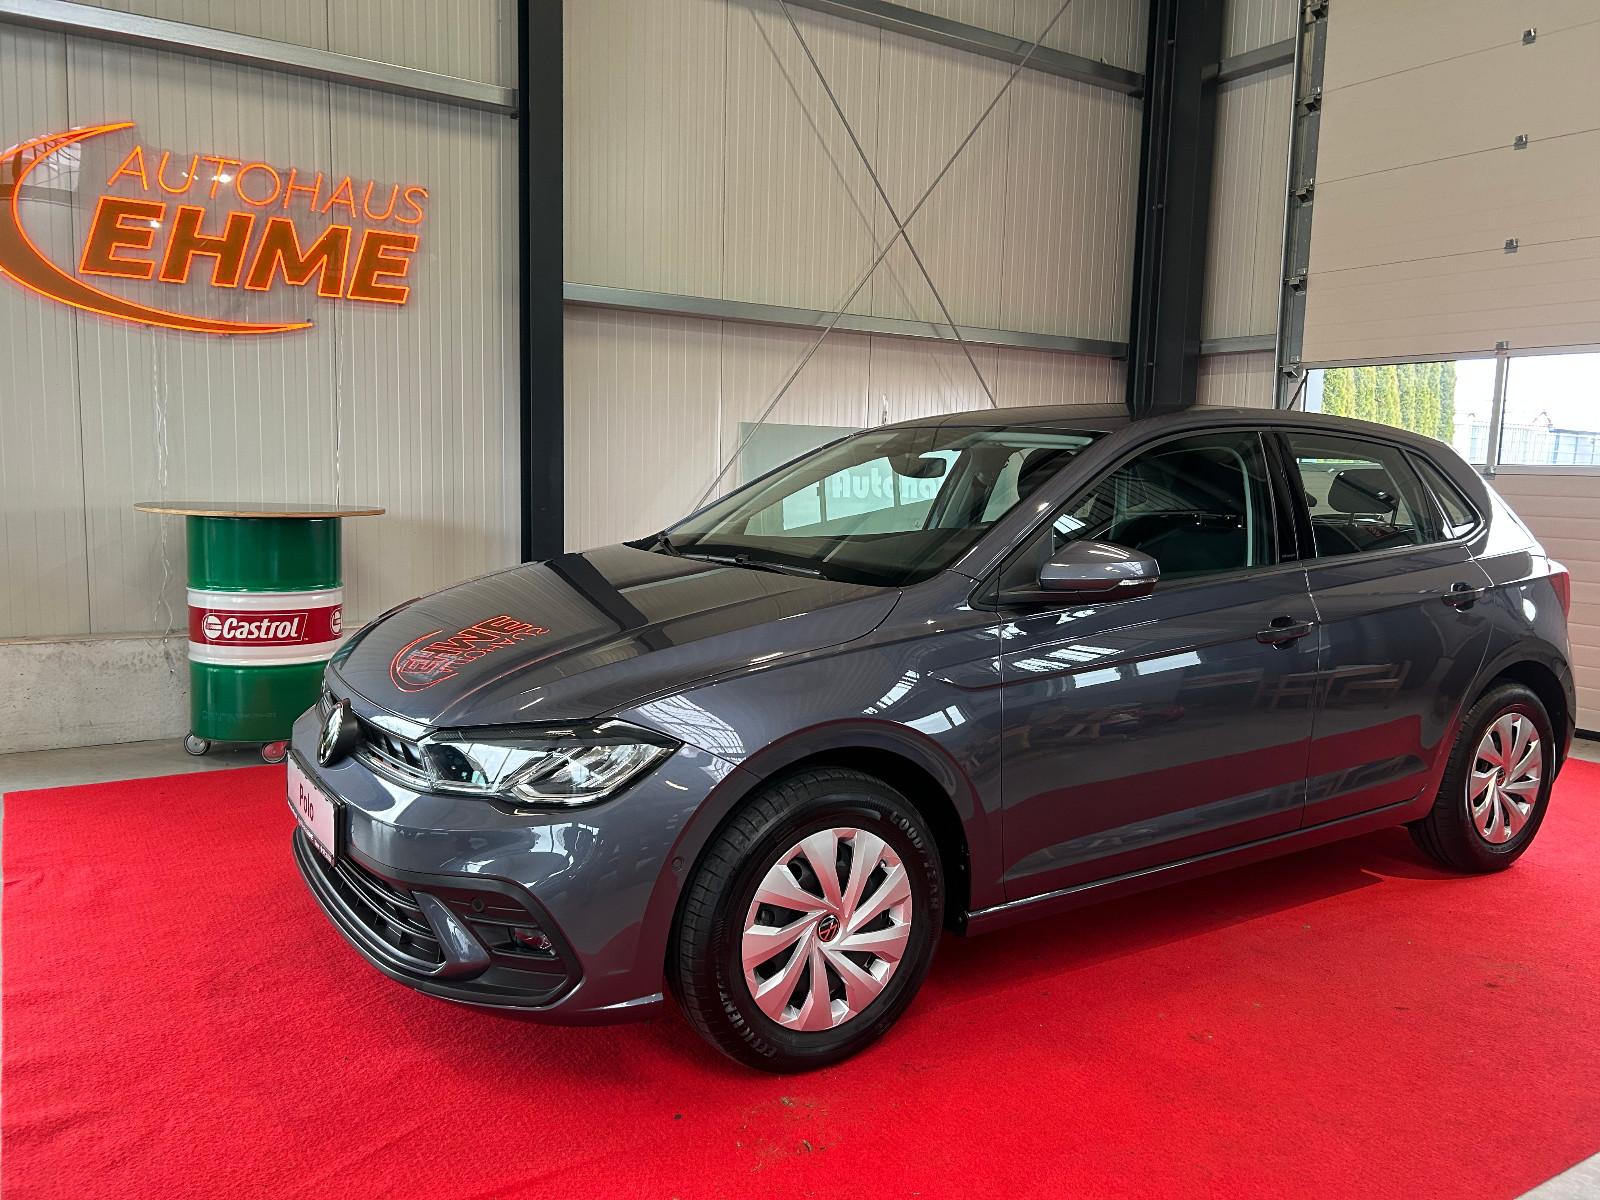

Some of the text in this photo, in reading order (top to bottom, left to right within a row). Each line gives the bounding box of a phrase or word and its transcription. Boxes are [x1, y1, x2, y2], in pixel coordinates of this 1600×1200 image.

[106, 144, 430, 225] AUTOHAUS
[79, 195, 421, 304] EHME
[222, 616, 300, 639] Castrol
[299, 783, 315, 822] Polo
